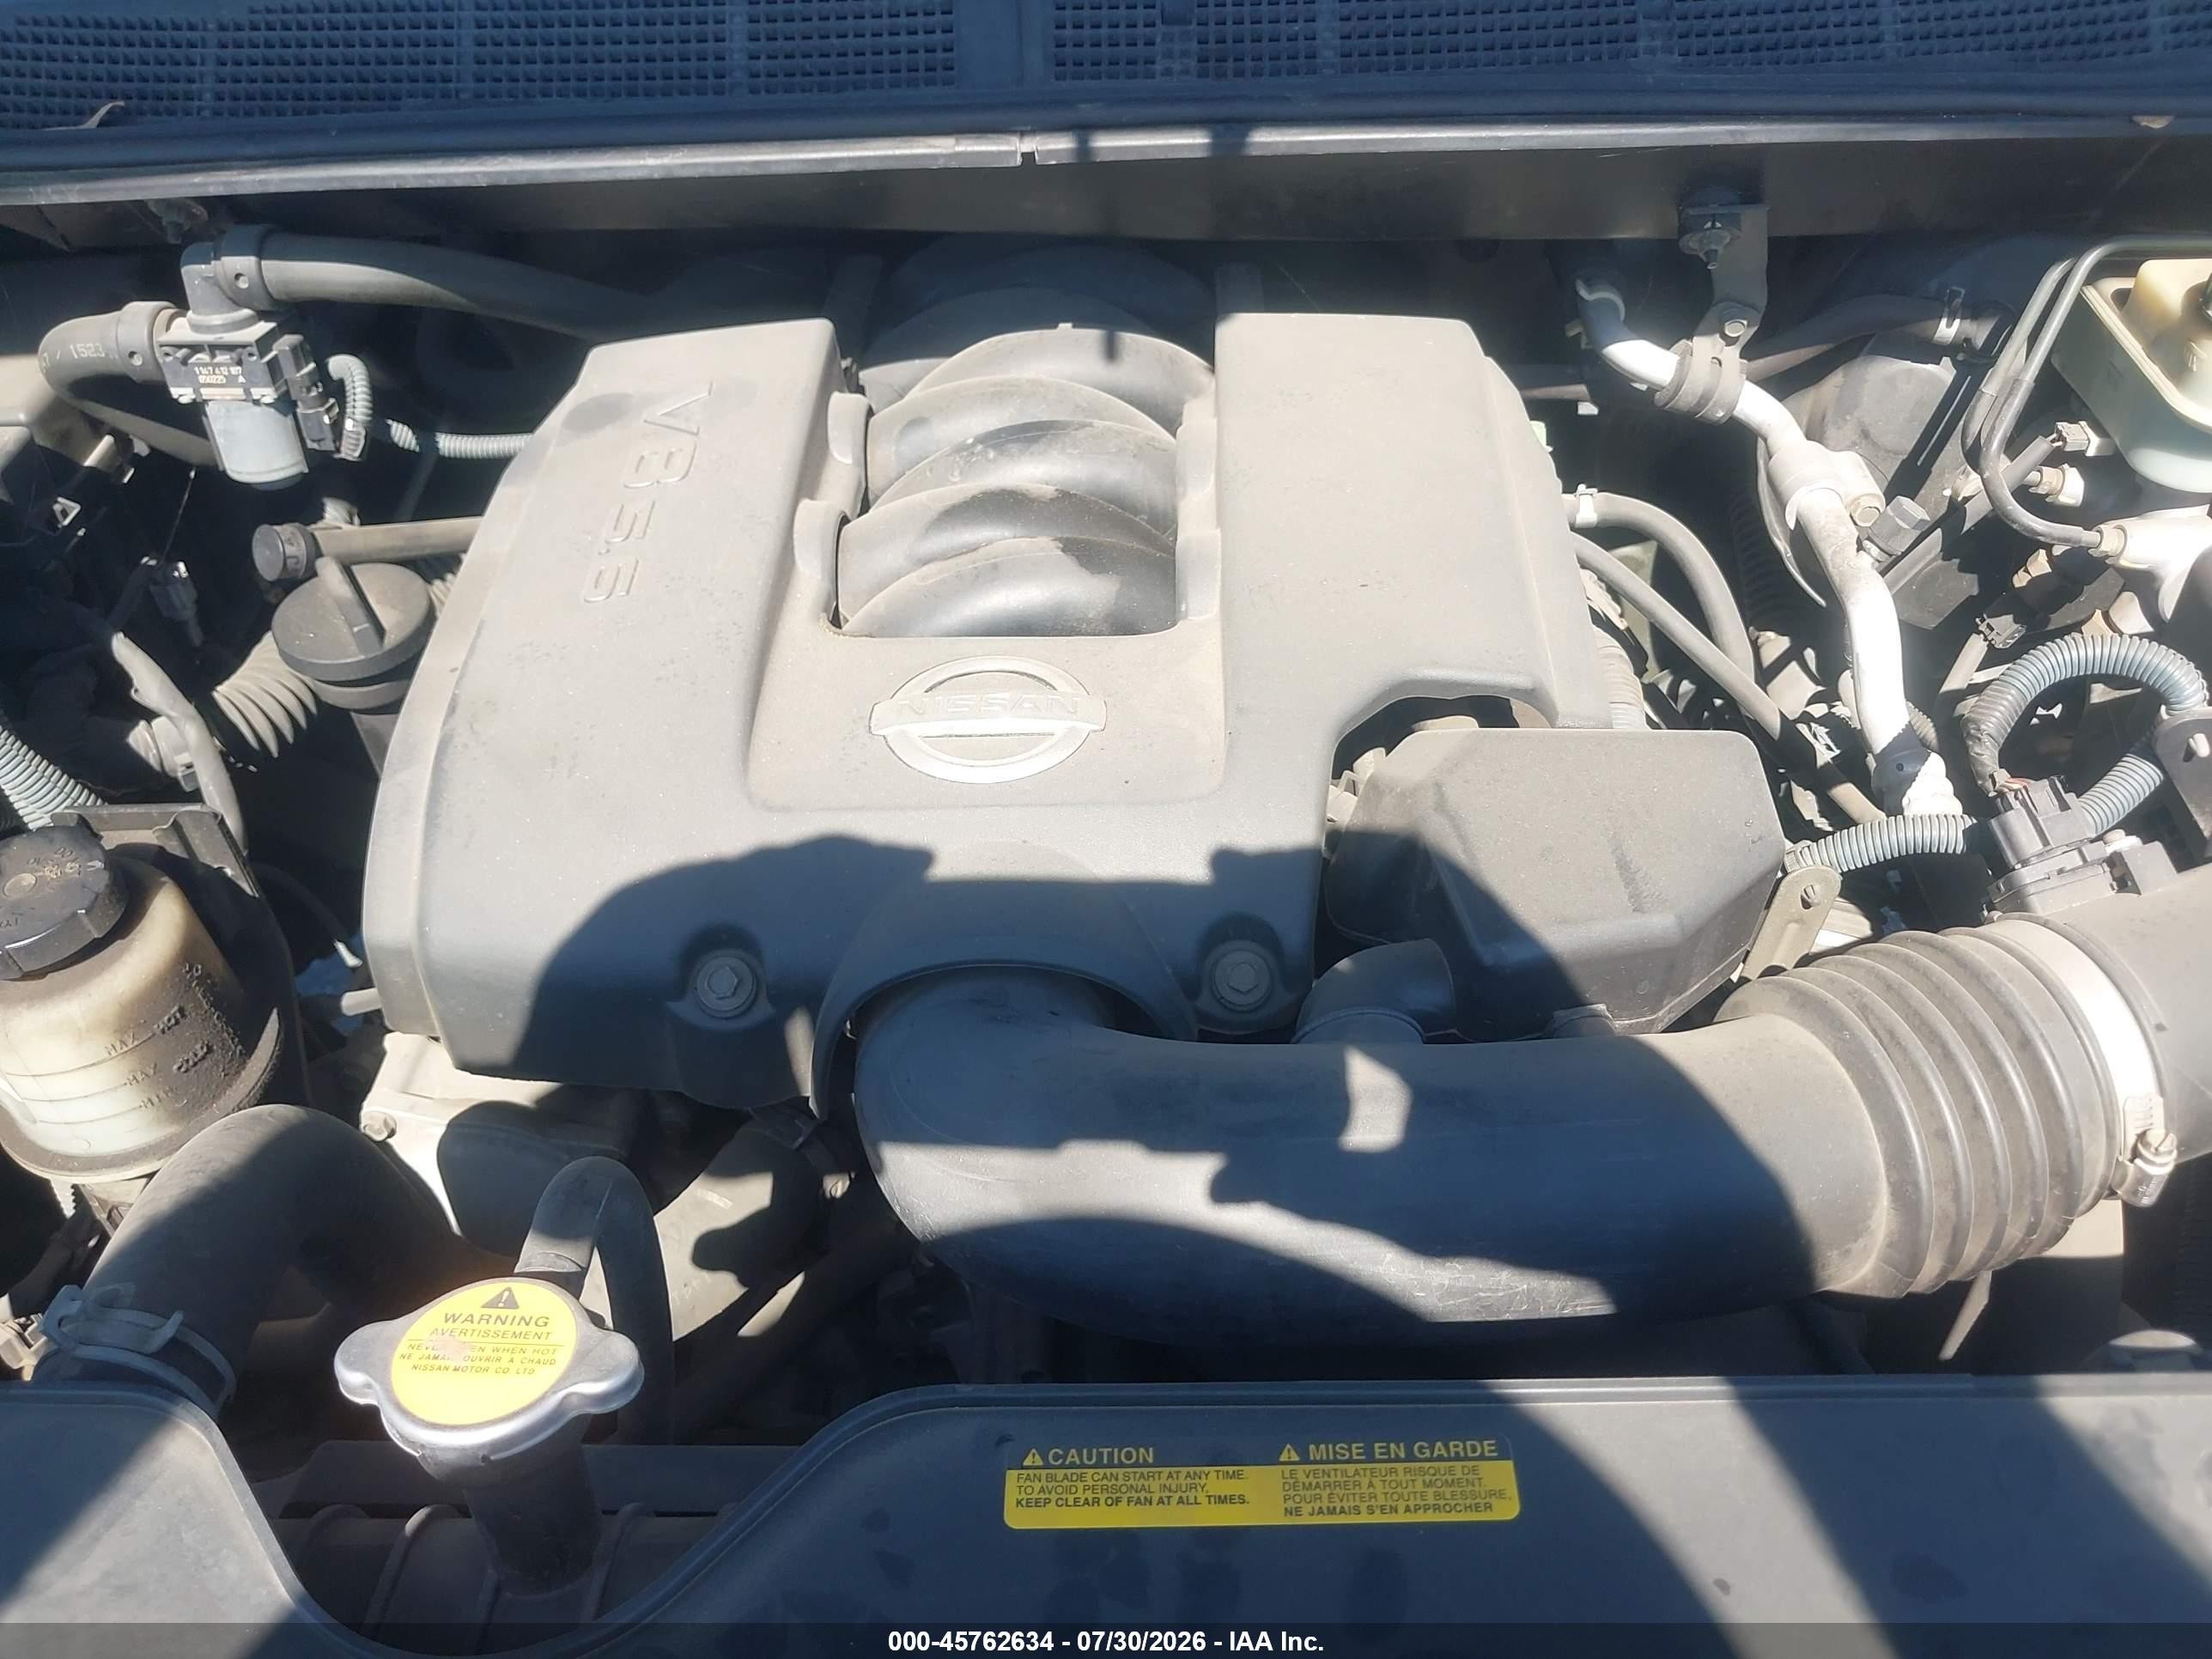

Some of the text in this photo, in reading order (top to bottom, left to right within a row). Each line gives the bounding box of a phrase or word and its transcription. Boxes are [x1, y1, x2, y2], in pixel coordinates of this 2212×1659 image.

[70, 343, 105, 359] 1523
[584, 382, 713, 603] V8 5.6
[897, 692, 1081, 716] NISSAN
[444, 1312, 550, 1328] WARNING
[429, 1328, 552, 1340] AVERTISSEMENT
[492, 1346, 527, 1354] WHEN
[463, 1354, 502, 1363] OUVRIR
[520, 1357, 556, 1365] CHAUD
[452, 1364, 489, 1373] MOTOR
[1048, 1447, 1154, 1466] CAUTION
[1309, 1439, 1498, 1461] MISE EN GARDE
[1017, 1473, 1042, 1483] FAN
[1045, 1472, 1088, 1483] BLADE
[1091, 1471, 1119, 1482] CAN
[1122, 1471, 1163, 1482] START
[1166, 1470, 1182, 1481] AT
[1184, 1469, 1211, 1480] ANY
[1281, 1465, 1480, 1480] LE VENTILATEUR RISQUE DE
[1017, 1485, 1034, 1496] TO
[1037, 1484, 1079, 1496] AVOID
[1082, 1483, 1155, 1495] PERSONAL
[1379, 1478, 1417, 1490] TOUT
[1016, 1493, 1249, 1508] KEEP CLEAR OF FAN AT ALL TIMES.
[1283, 1492, 1322, 1504] POUR
[1382, 1491, 1429, 1503] TOUTE
[1284, 1501, 1493, 1517] NE JAMAIS S'EN APPROCHER
